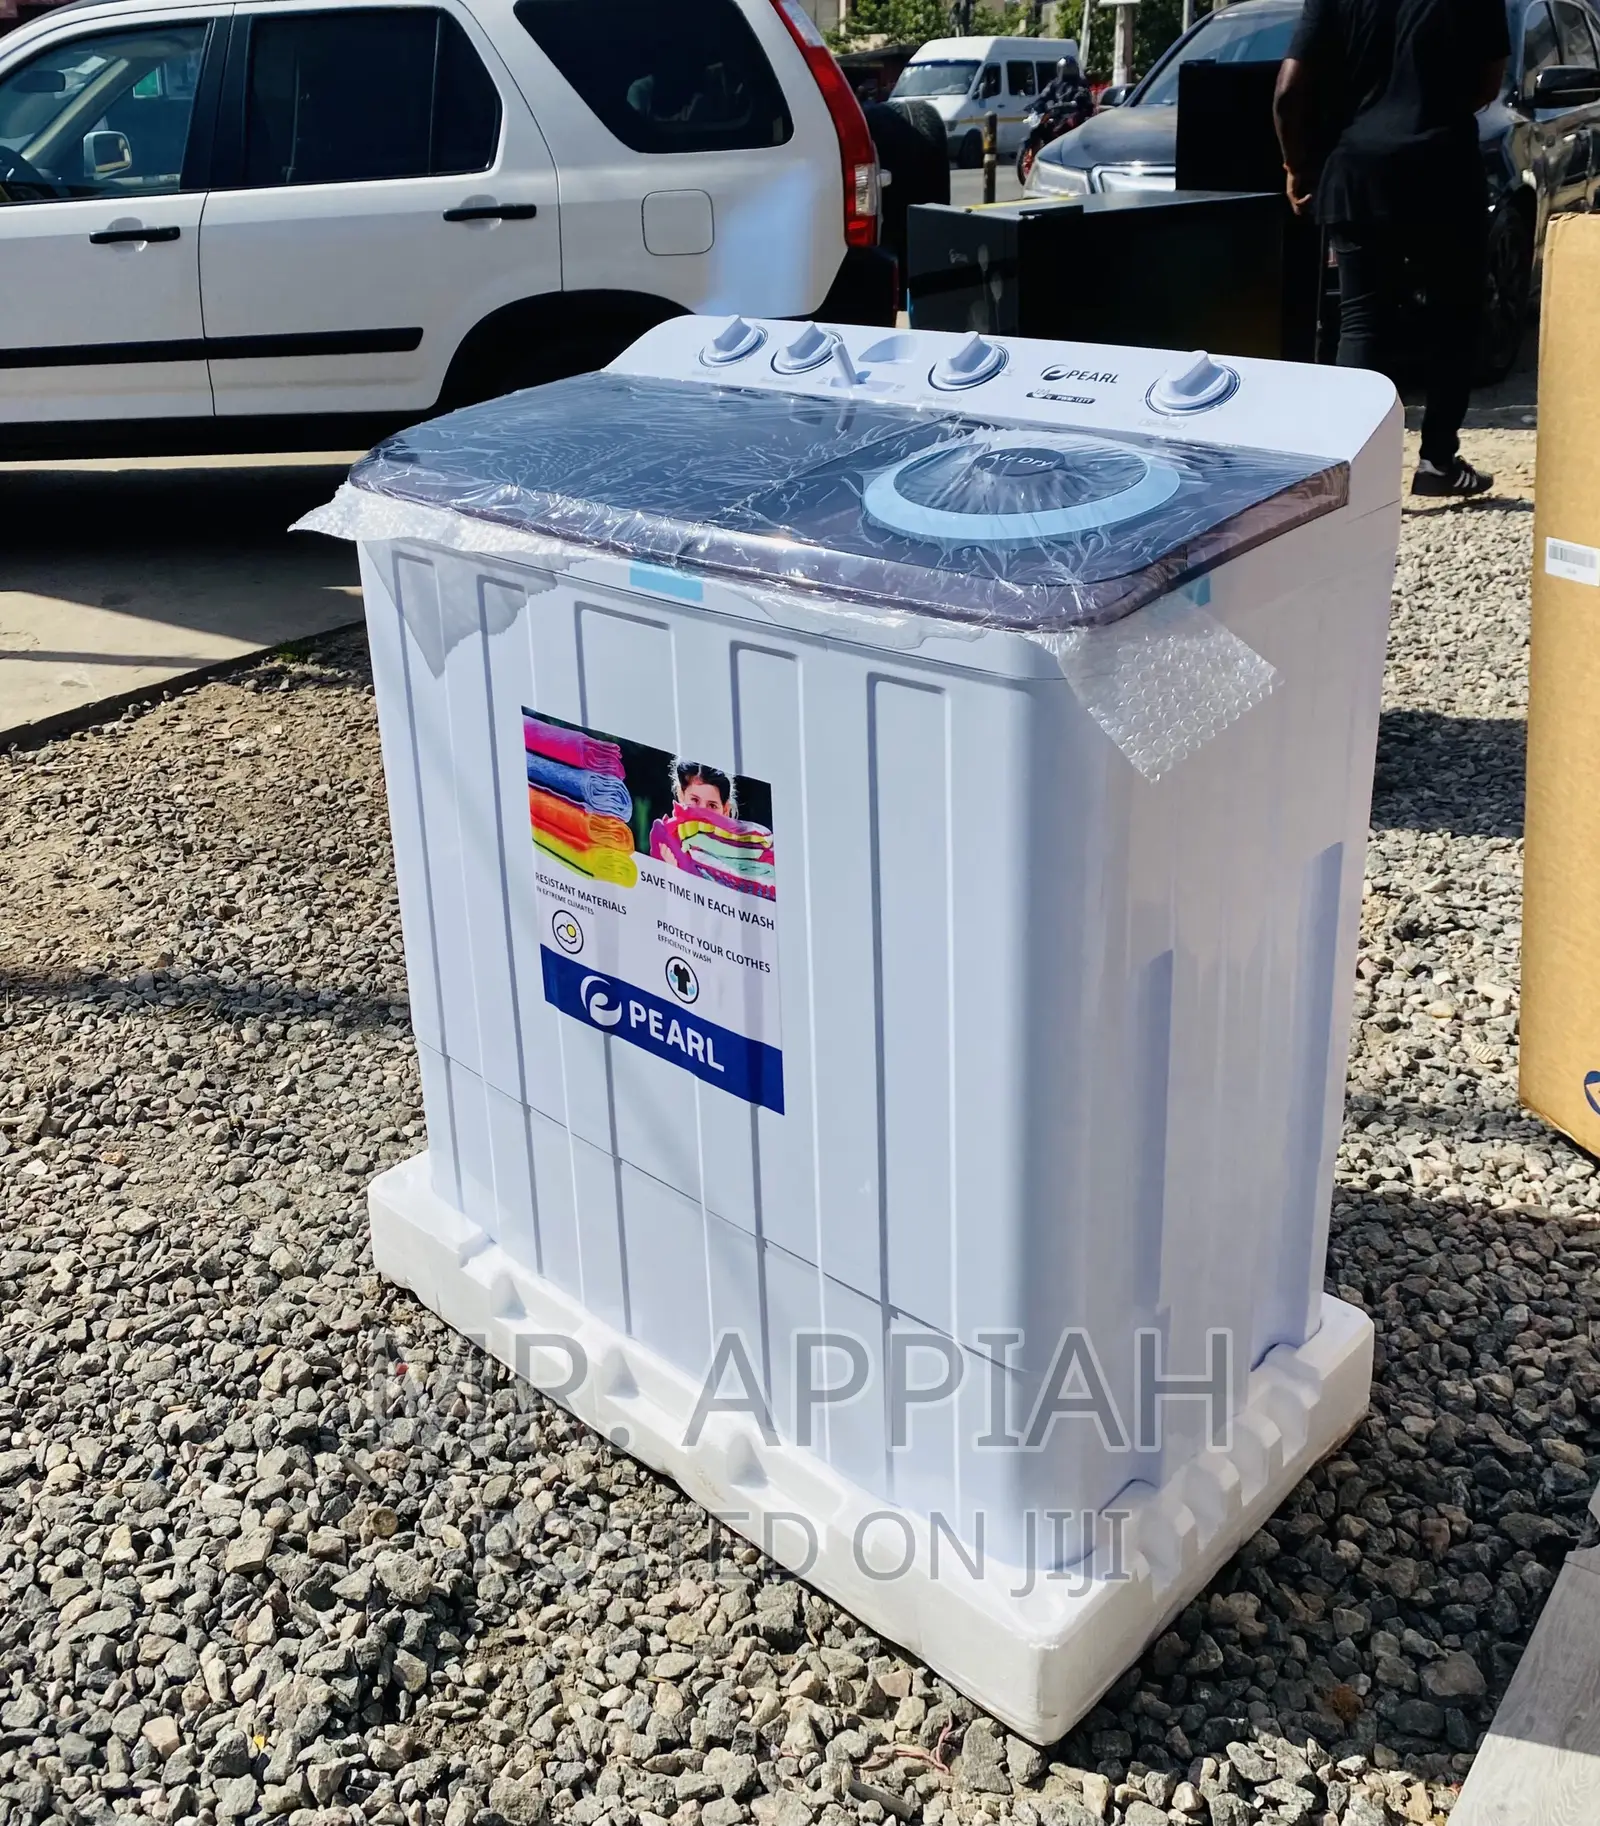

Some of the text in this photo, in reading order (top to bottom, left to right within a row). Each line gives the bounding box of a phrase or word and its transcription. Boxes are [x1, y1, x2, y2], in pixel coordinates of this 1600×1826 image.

[1066, 369, 1119, 384] PEARL
[1018, 457, 1053, 467] Dry
[535, 871, 627, 915] RESISTANT MATERIALS
[542, 888, 567, 904] EXTREME
[567, 898, 595, 915] CLIMATES
[640, 870, 774, 930] SAVE TIME IN EACH WASH
[657, 919, 771, 973] PROTECT YOUR CLOTHES
[657, 934, 712, 964] EFFICIENTLY WASH
[628, 1000, 725, 1073] PEARL
